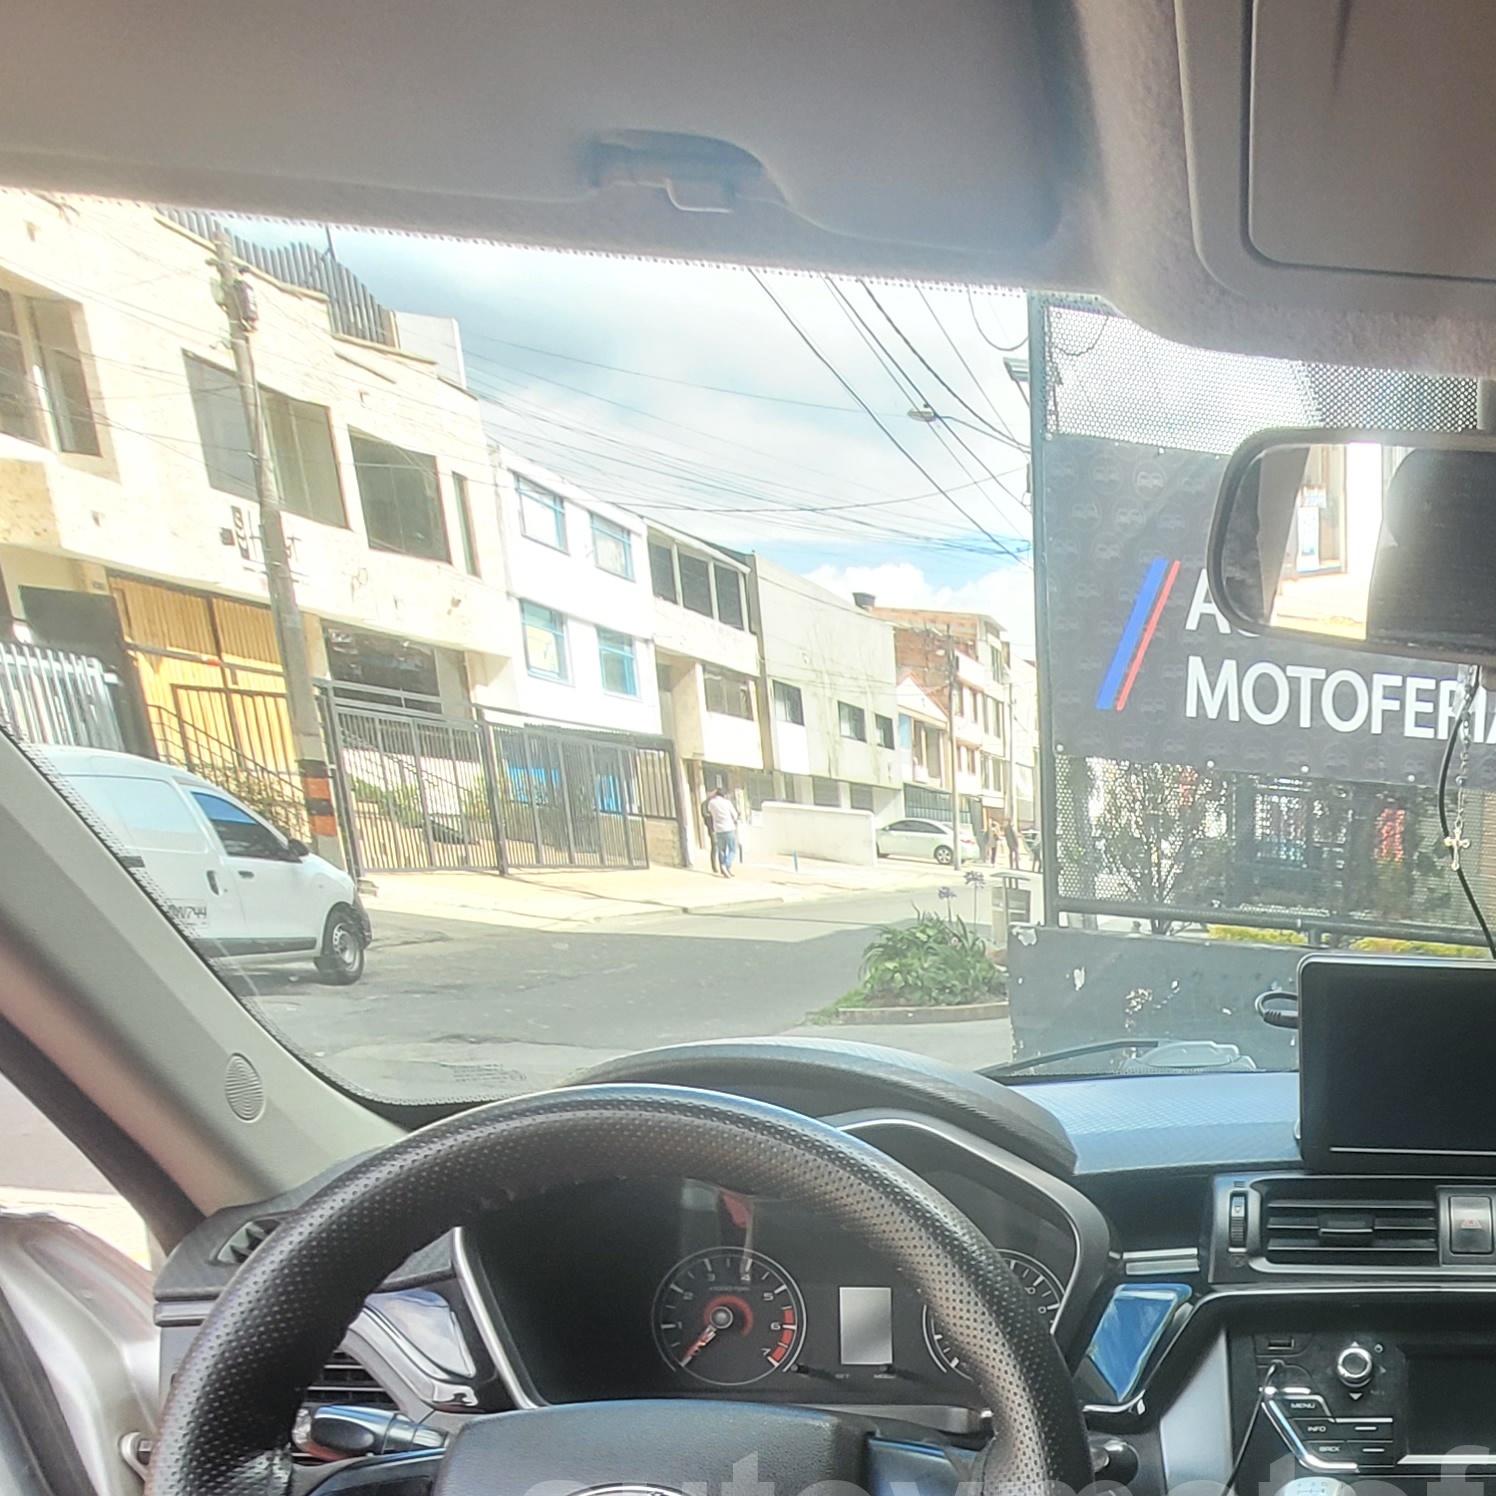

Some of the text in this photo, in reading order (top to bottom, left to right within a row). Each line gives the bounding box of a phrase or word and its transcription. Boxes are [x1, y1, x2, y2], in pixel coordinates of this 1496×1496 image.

[763, 1292, 774, 1301] 5
[770, 1321, 781, 1331] 6
[1307, 1425, 1327, 1433] INFO
